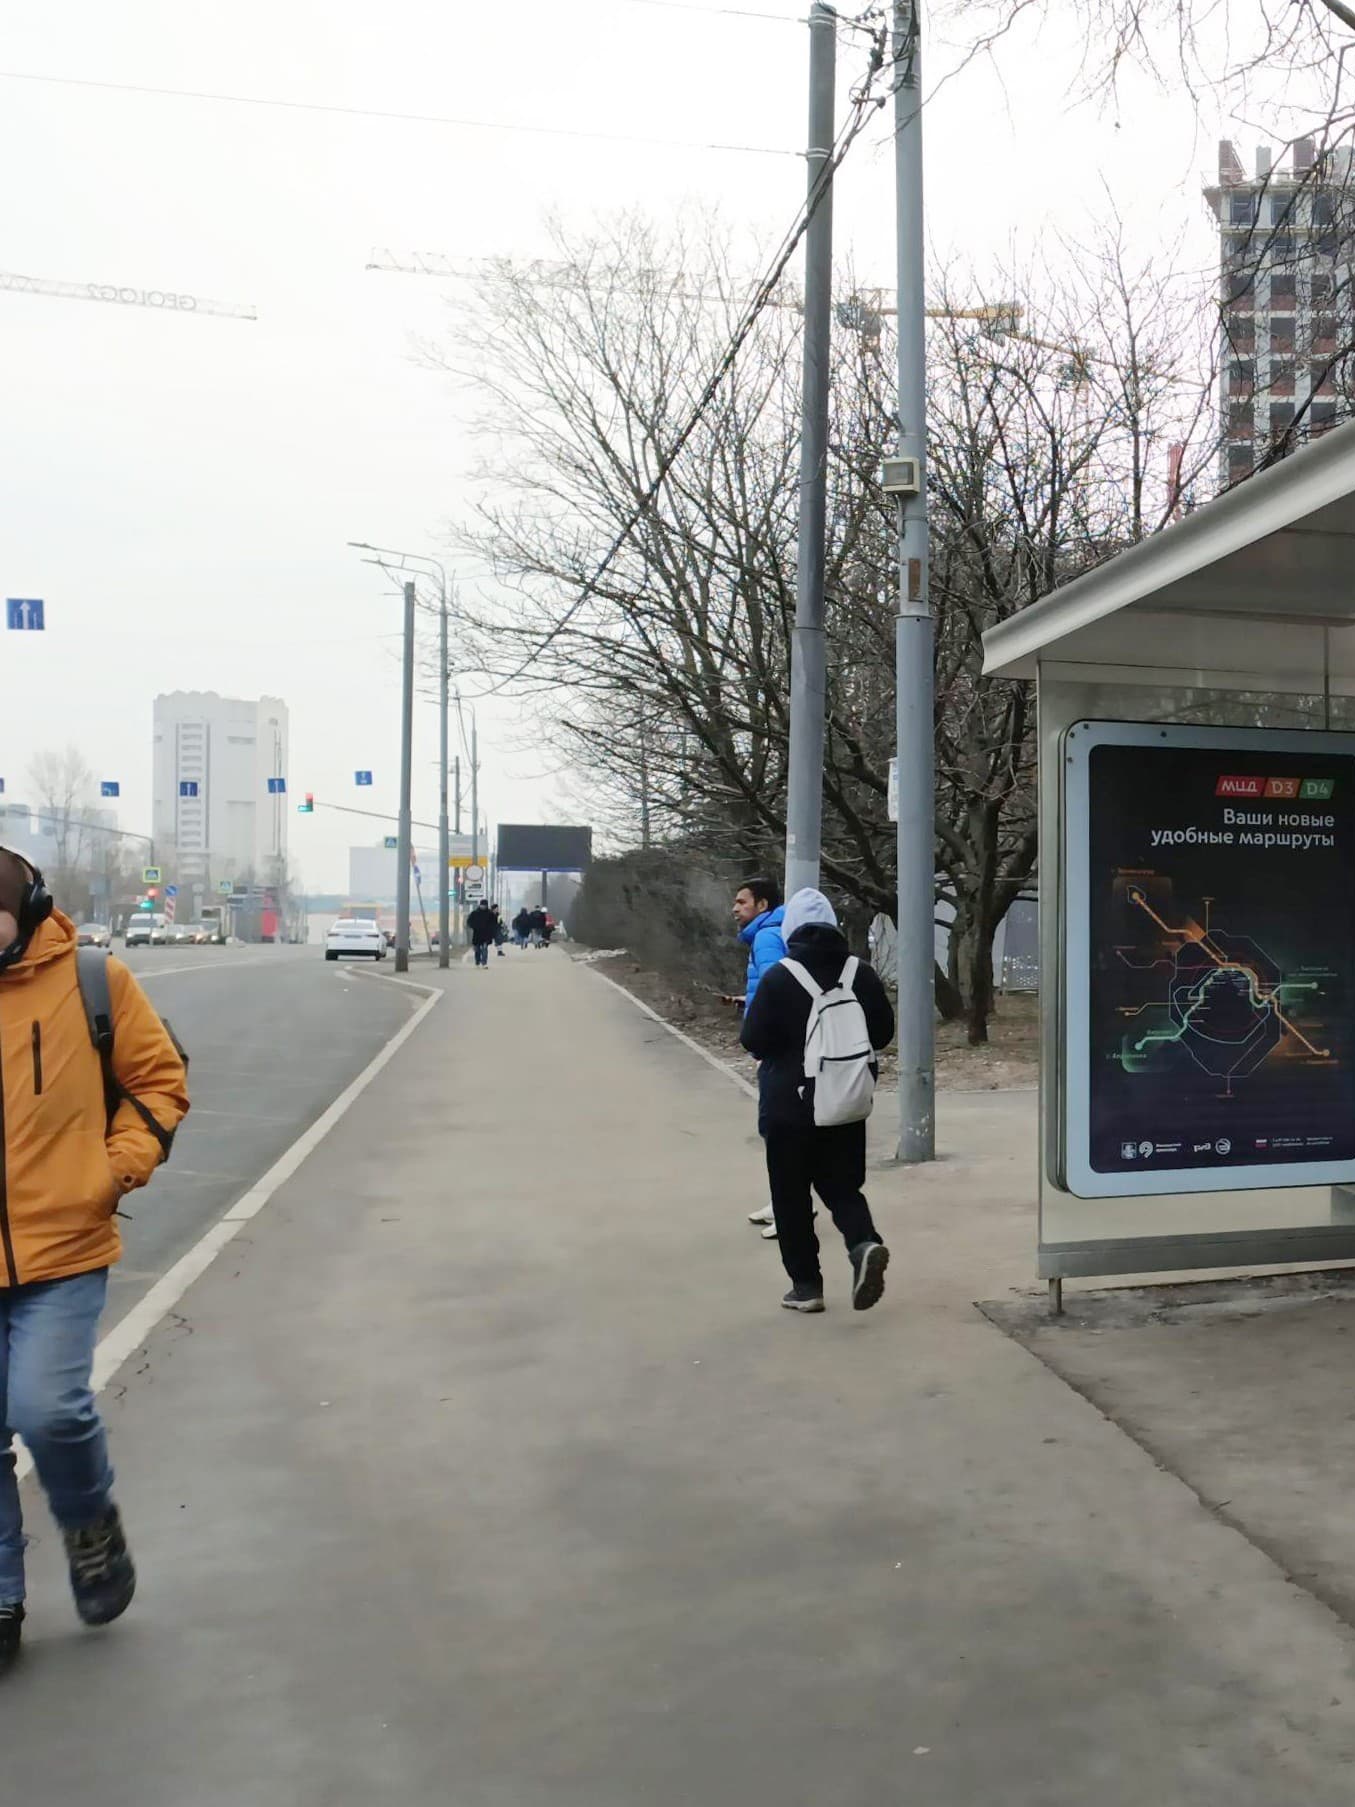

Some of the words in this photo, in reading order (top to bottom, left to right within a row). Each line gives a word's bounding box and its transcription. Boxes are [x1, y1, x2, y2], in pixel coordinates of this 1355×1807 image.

[1222, 781, 1258, 793] МЦД
[1271, 781, 1294, 795] D3
[1306, 782, 1329, 796] D4
[1223, 808, 1272, 826] Ваши
[1278, 814, 1335, 827] новые
[1151, 828, 1234, 847] удобные
[1240, 832, 1335, 850] маршруты
